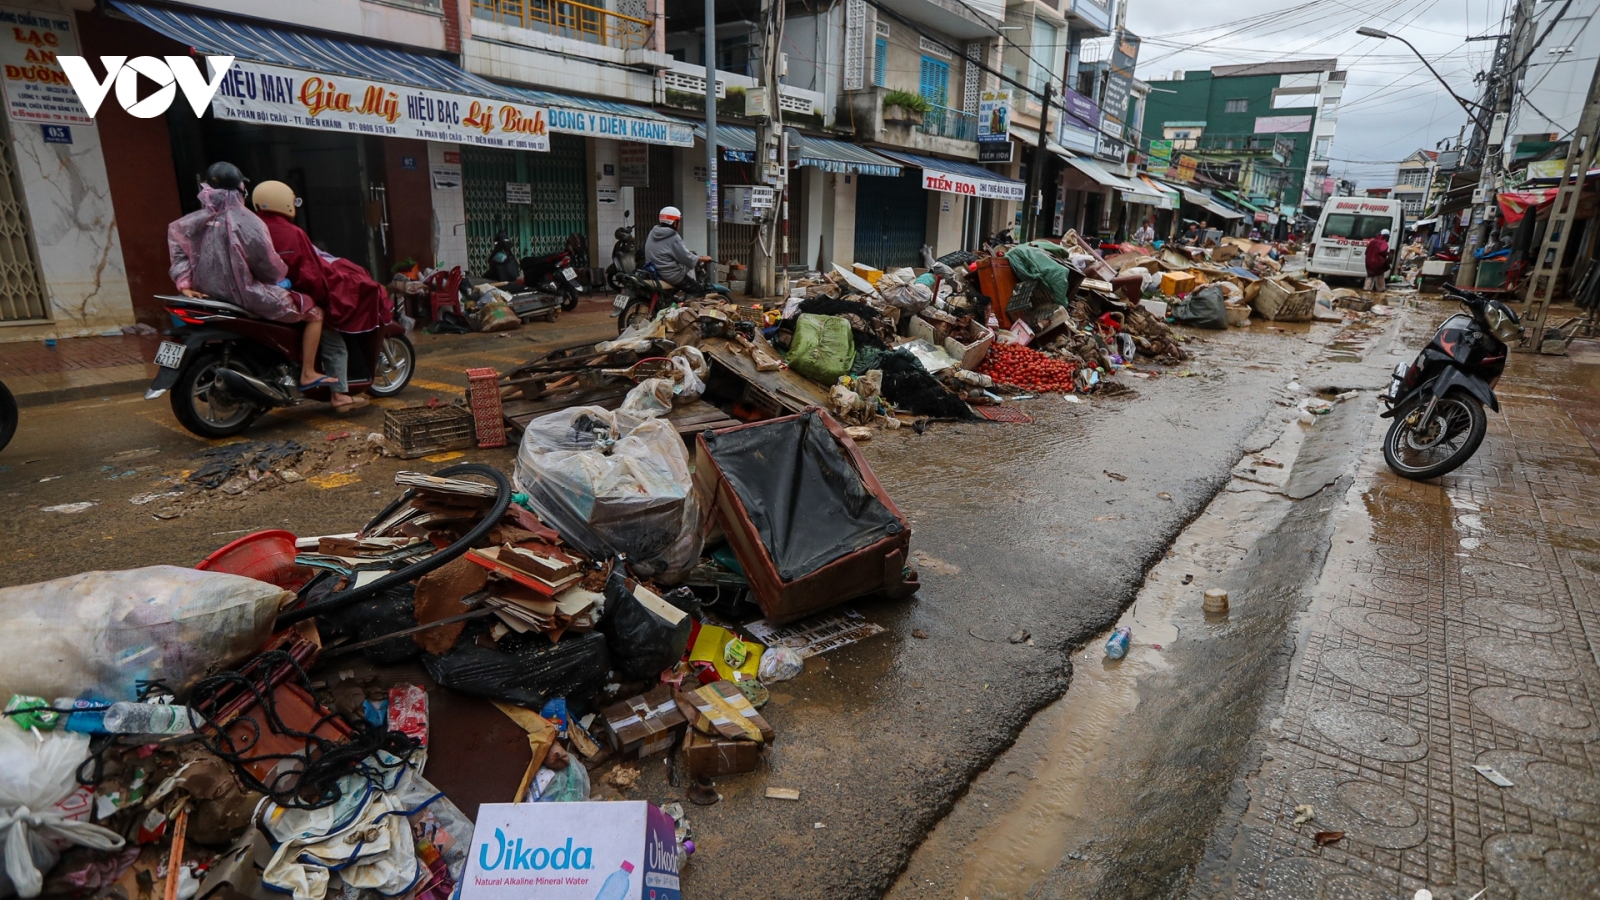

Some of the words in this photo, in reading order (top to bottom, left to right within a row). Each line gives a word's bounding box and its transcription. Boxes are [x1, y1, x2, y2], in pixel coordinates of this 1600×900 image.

[12, 27, 59, 48] LẠC
[25, 48, 57, 66] AN
[260, 73, 293, 104] MAY
[297, 77, 353, 117] Gia
[355, 85, 401, 124] Mỹ
[407, 92, 434, 126] HIỆU
[437, 98, 460, 129] BẠC
[462, 100, 495, 135] Lý
[499, 105, 547, 136] Bình
[226, 107, 236, 117] 7A
[237, 109, 255, 119] PHAN
[257, 110, 269, 123] BỘI
[270, 113, 288, 123] CHÂU
[549, 108, 585, 131] ĐÔNG
[588, 115, 596, 132] Y
[630, 118, 667, 140] KHÁNH
[48, 127, 65, 138] 05
[416, 129, 424, 137] 7A
[424, 130, 438, 139] PHAN
[439, 131, 448, 140] BỘI
[926, 174, 952, 191] TIẾN
[955, 182, 976, 195] HOA
[762, 628, 791, 644] CHAY
[479, 827, 592, 871] Vikoda
[475, 877, 503, 886] Natural
[504, 877, 534, 886] Alkaline
[535, 877, 564, 885] Mineral
[565, 877, 589, 885] Water
